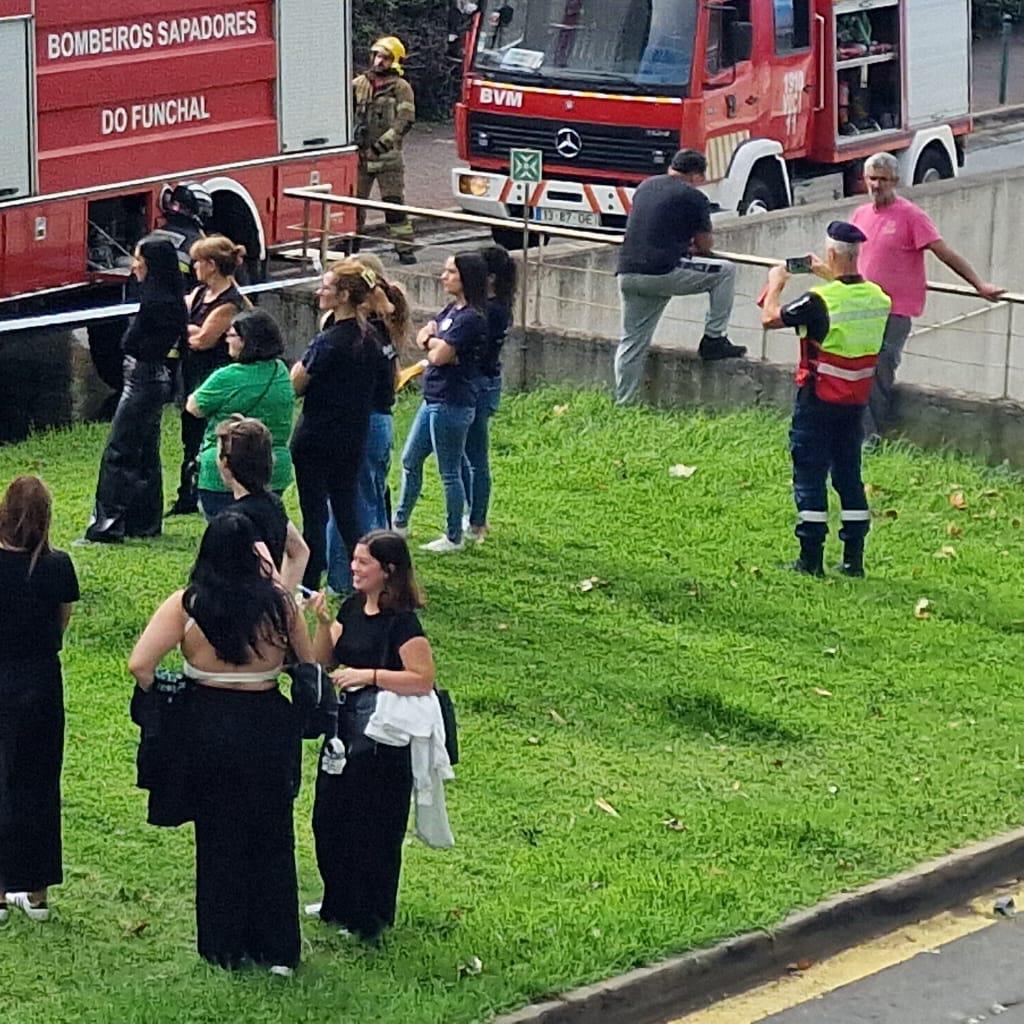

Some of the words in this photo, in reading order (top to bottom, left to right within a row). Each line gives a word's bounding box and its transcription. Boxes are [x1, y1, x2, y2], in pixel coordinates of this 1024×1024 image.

[47, 25, 153, 59] BOMBEIROS
[157, 10, 257, 45] SAPADORES
[102, 108, 127, 134] DO
[131, 95, 211, 130] FUNCHAL
[479, 87, 523, 108] BVM
